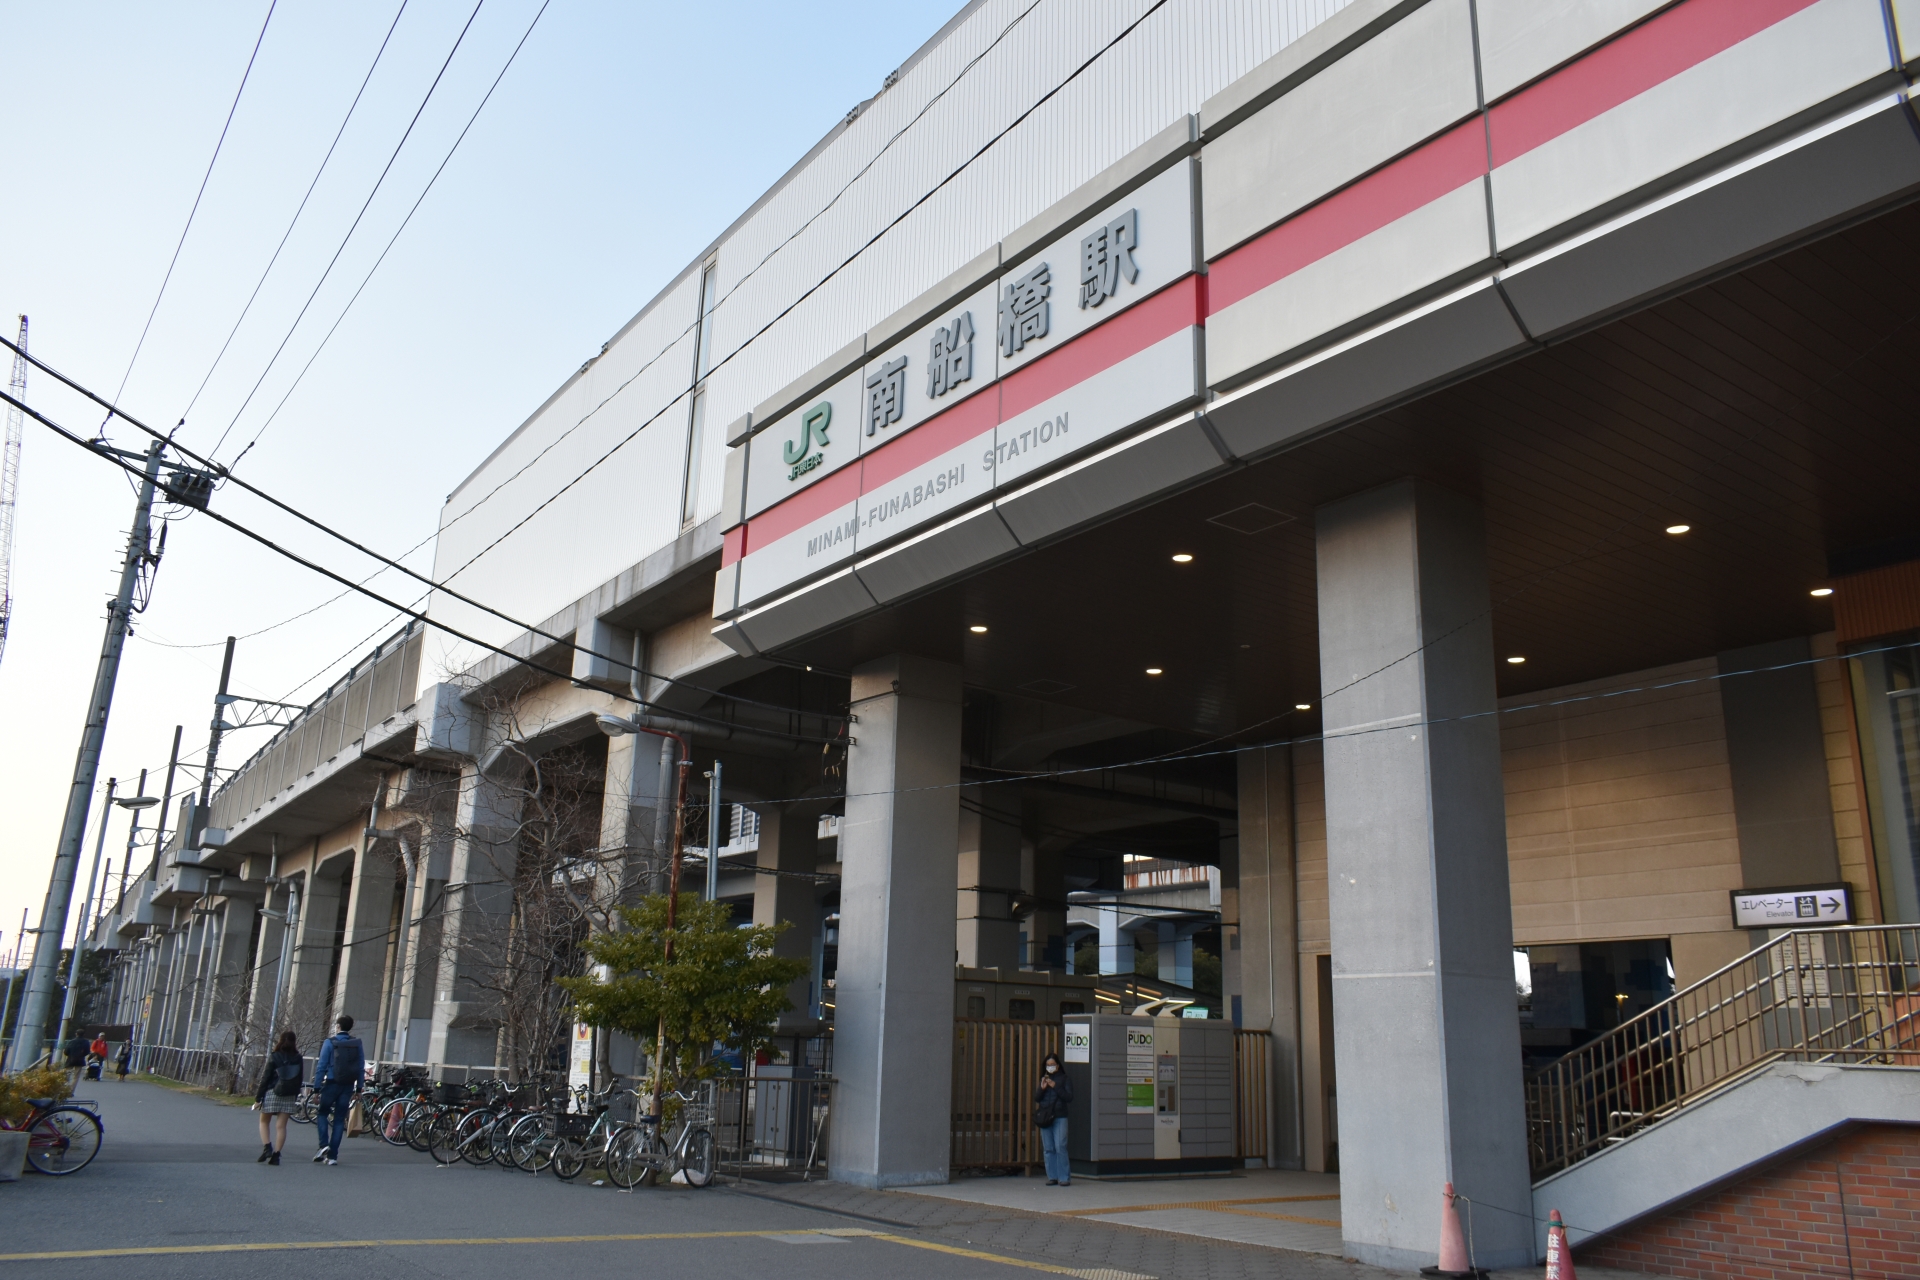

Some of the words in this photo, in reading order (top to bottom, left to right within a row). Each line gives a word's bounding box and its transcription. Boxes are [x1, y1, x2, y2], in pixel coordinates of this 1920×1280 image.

[866, 208, 1139, 437] 南船橋駅
[783, 401, 832, 465] JR
[788, 452, 823, 481] JR東日本
[807, 463, 965, 557] MINAMI-FUNABASHI
[982, 412, 1069, 471] STATION
[1741, 898, 1793, 910] エレベーター
[1066, 1035, 1088, 1046] PUDO
[1128, 1033, 1153, 1045] PUDO
